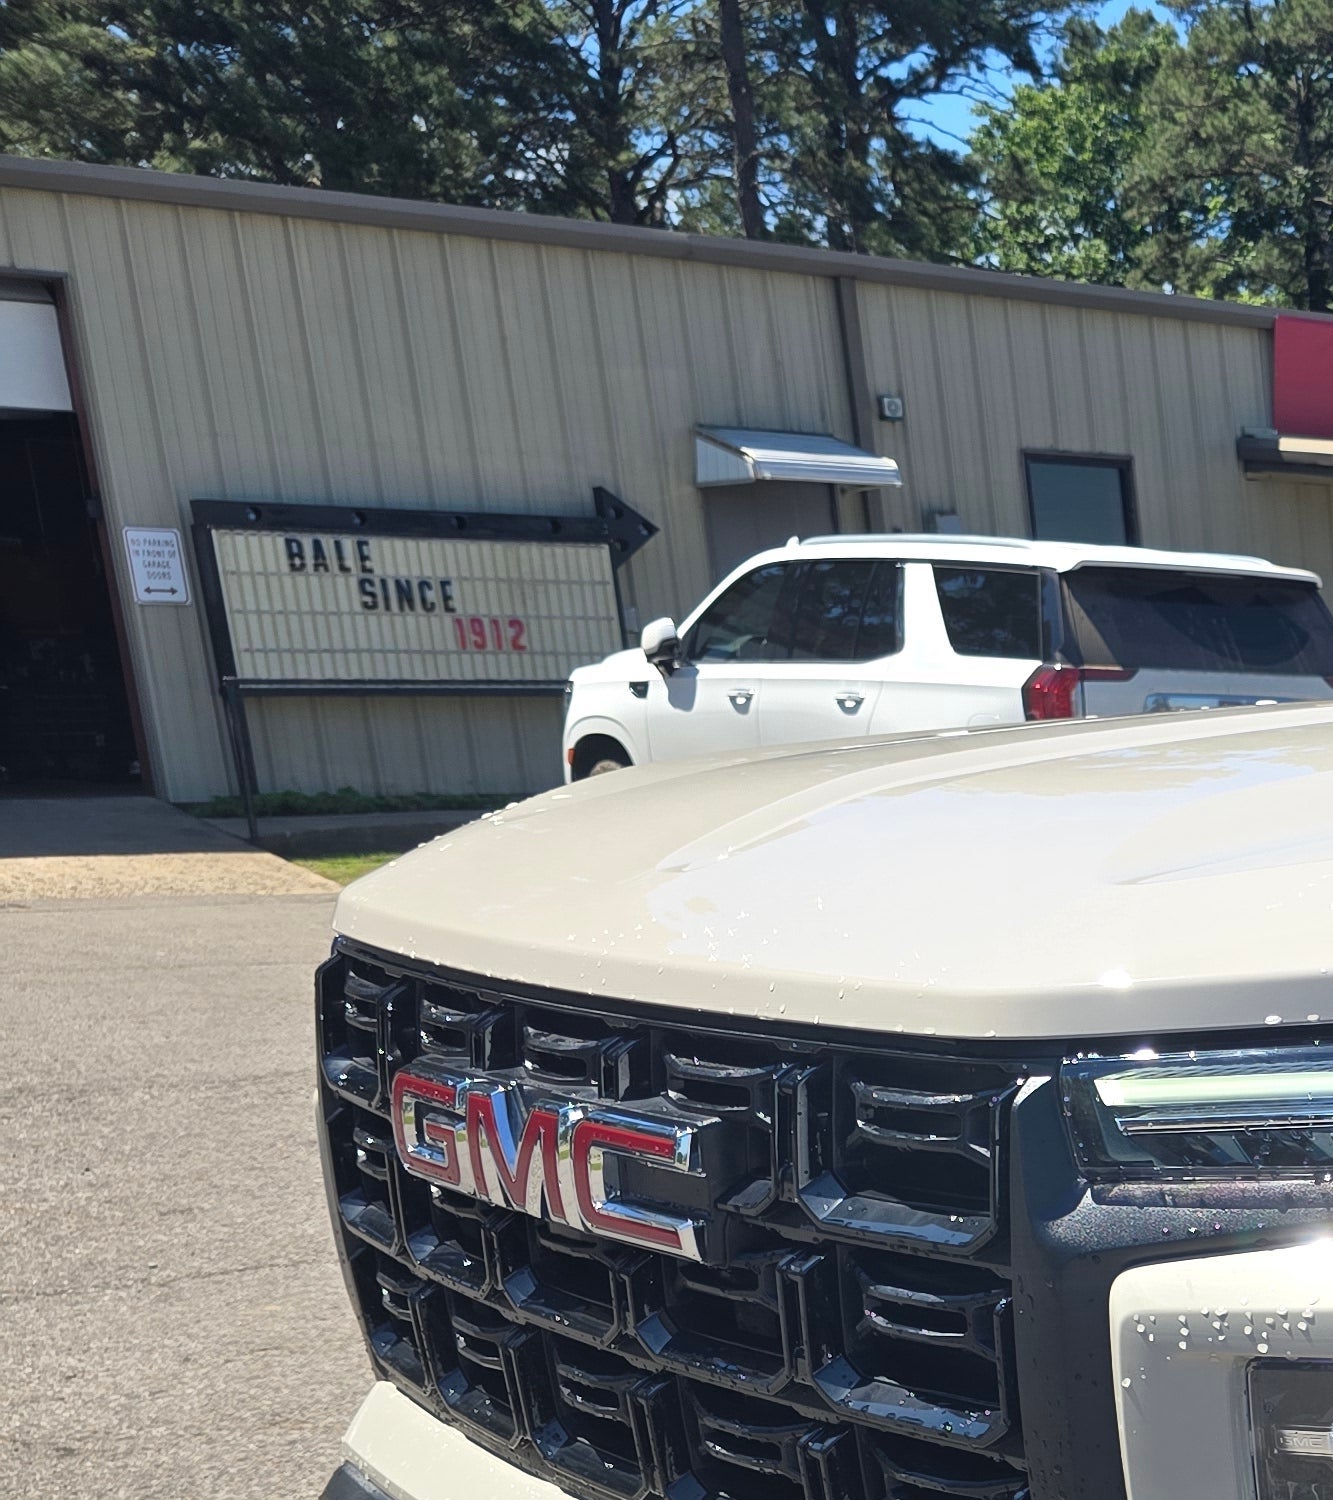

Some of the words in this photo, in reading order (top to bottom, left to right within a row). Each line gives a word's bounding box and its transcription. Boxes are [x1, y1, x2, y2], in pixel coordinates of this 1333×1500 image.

[131, 538, 141, 547] NO
[143, 538, 175, 548] PARKING
[132, 549, 141, 557] IN
[142, 549, 165, 559] FRONT
[143, 560, 171, 570] GARAGE
[284, 537, 375, 574] BALE
[146, 571, 172, 581] DOORS
[358, 577, 457, 613] SINCE
[455, 617, 527, 651] 1912
[391, 1071, 702, 1262] GMC
